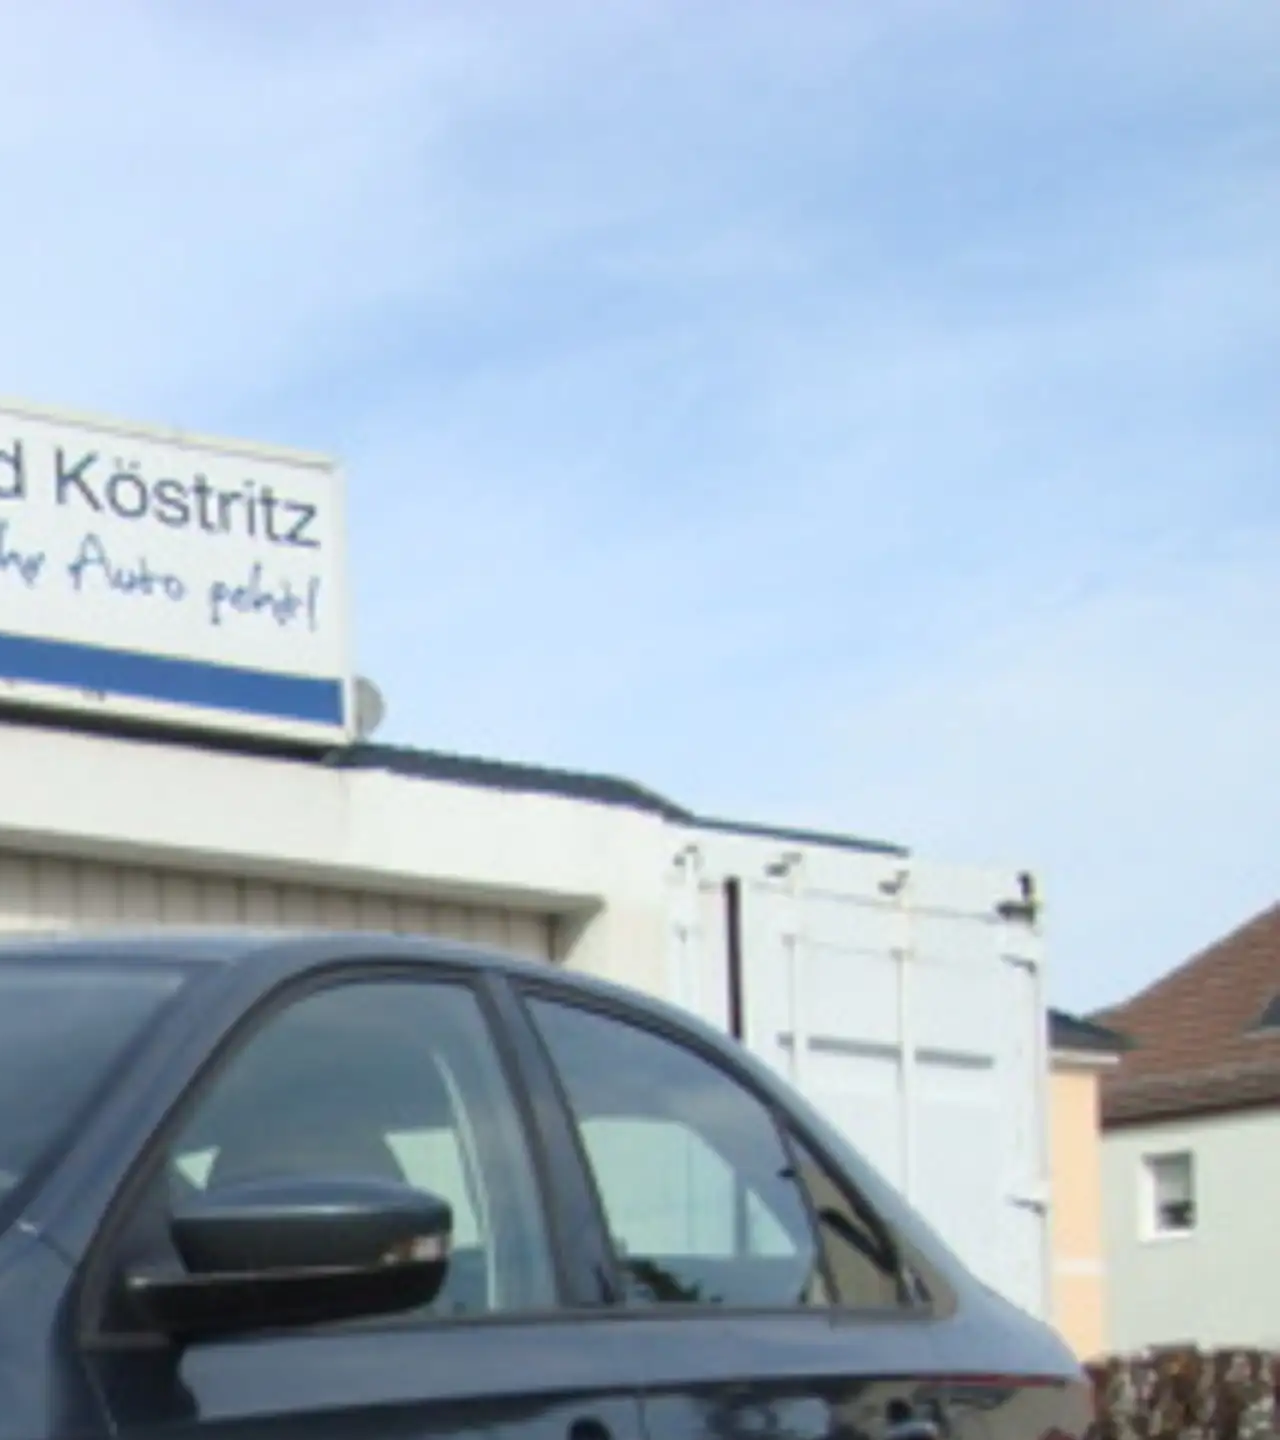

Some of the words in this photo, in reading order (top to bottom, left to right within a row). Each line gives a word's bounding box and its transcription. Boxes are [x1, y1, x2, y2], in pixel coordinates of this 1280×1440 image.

[52, 446, 322, 549] Köstritz
[67, 530, 187, 603] Auto
[209, 559, 323, 634] geht!
